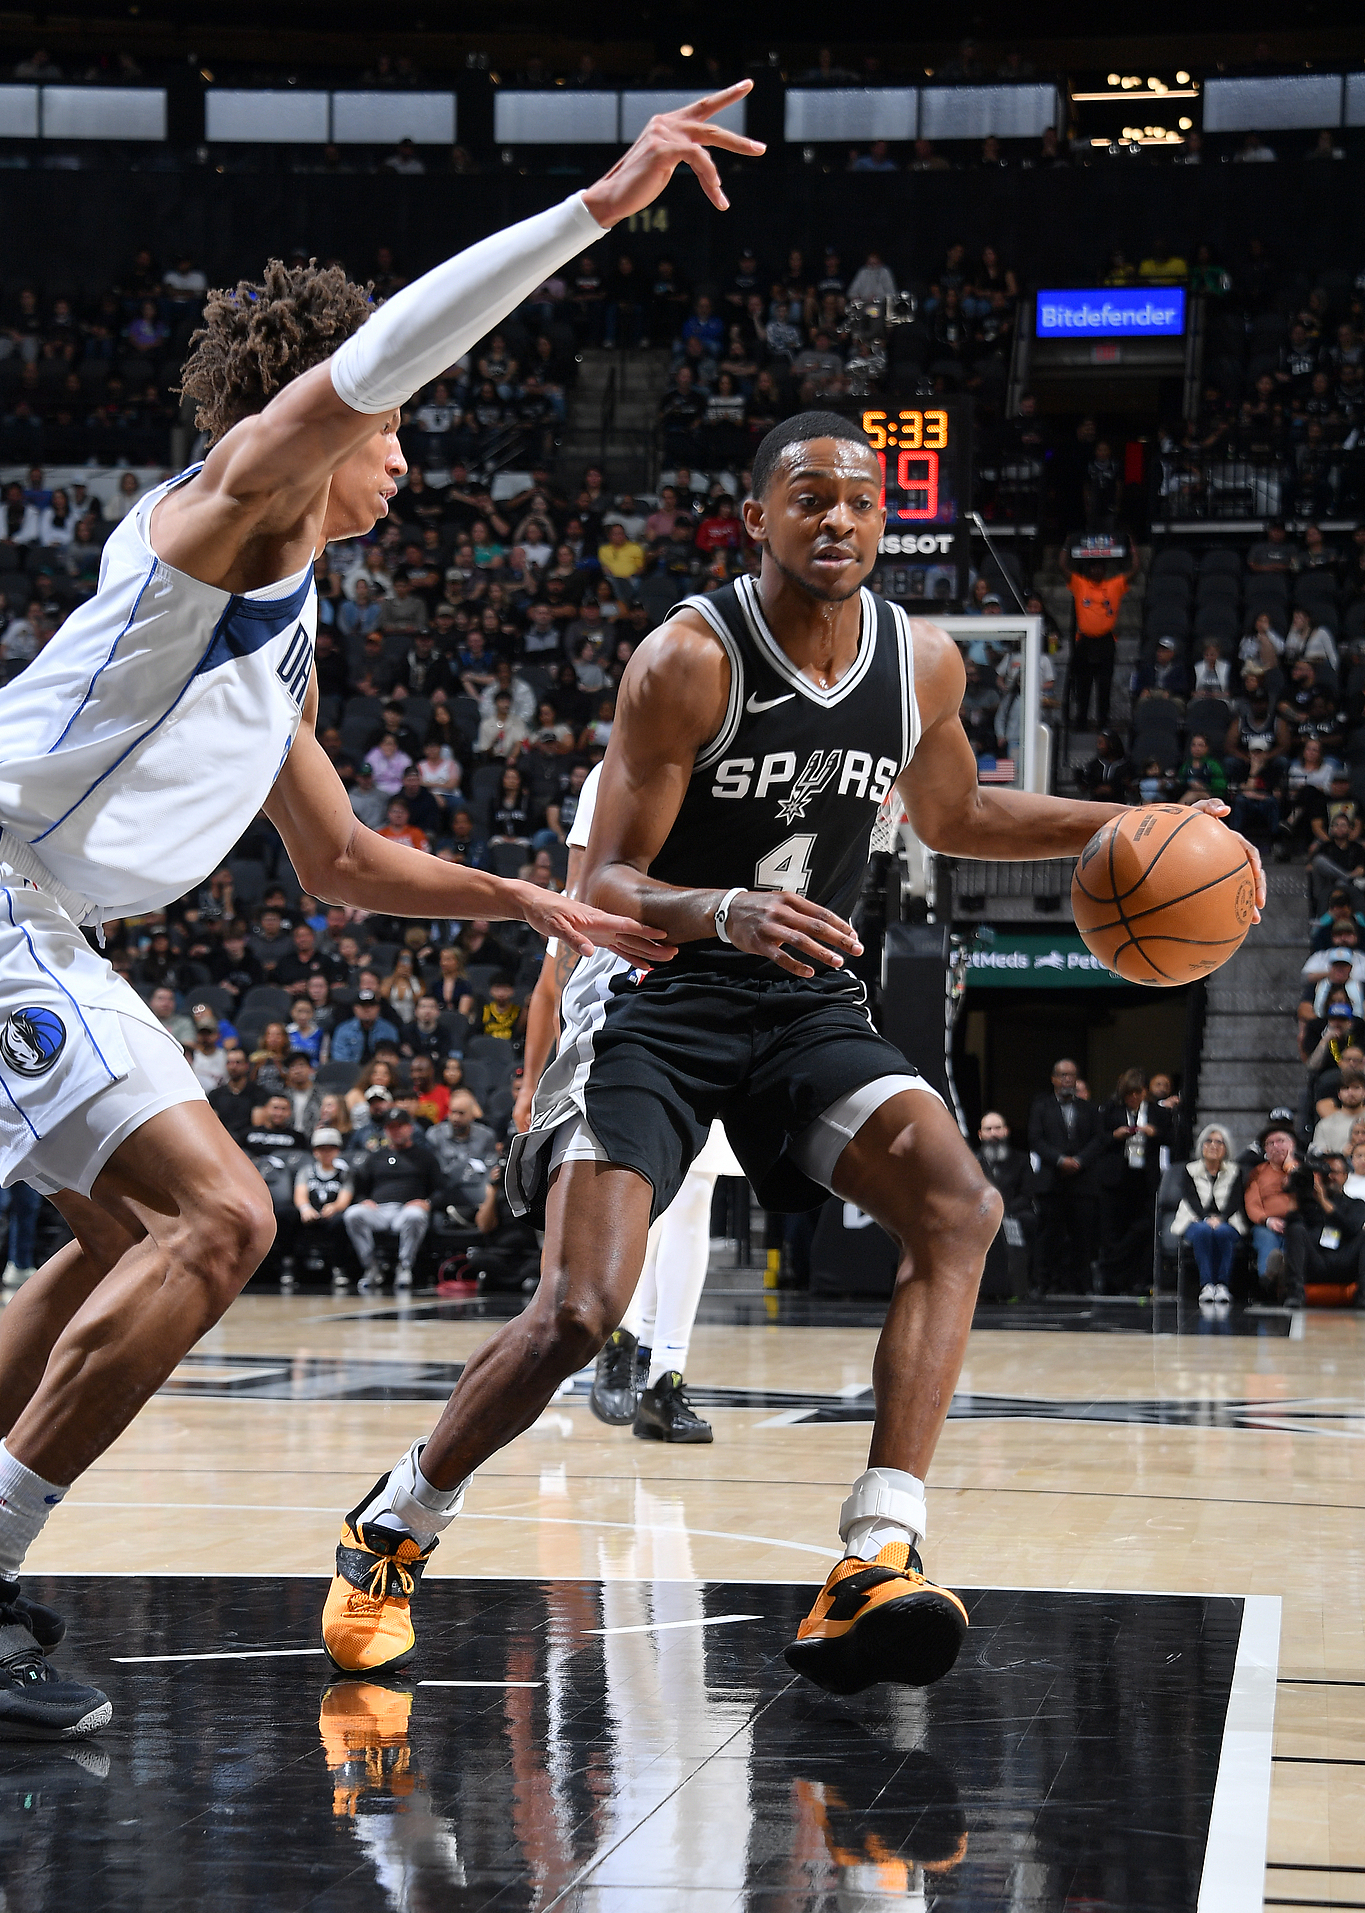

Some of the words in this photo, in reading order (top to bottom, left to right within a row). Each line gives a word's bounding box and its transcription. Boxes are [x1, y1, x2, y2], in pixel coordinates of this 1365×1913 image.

[629, 209, 668, 232] 114
[1041, 303, 1176, 328] Bitdefender
[862, 410, 948, 449] 5:33
[877, 533, 956, 555] ISSOT
[711, 749, 898, 825] SPURS
[754, 833, 818, 898] 4
